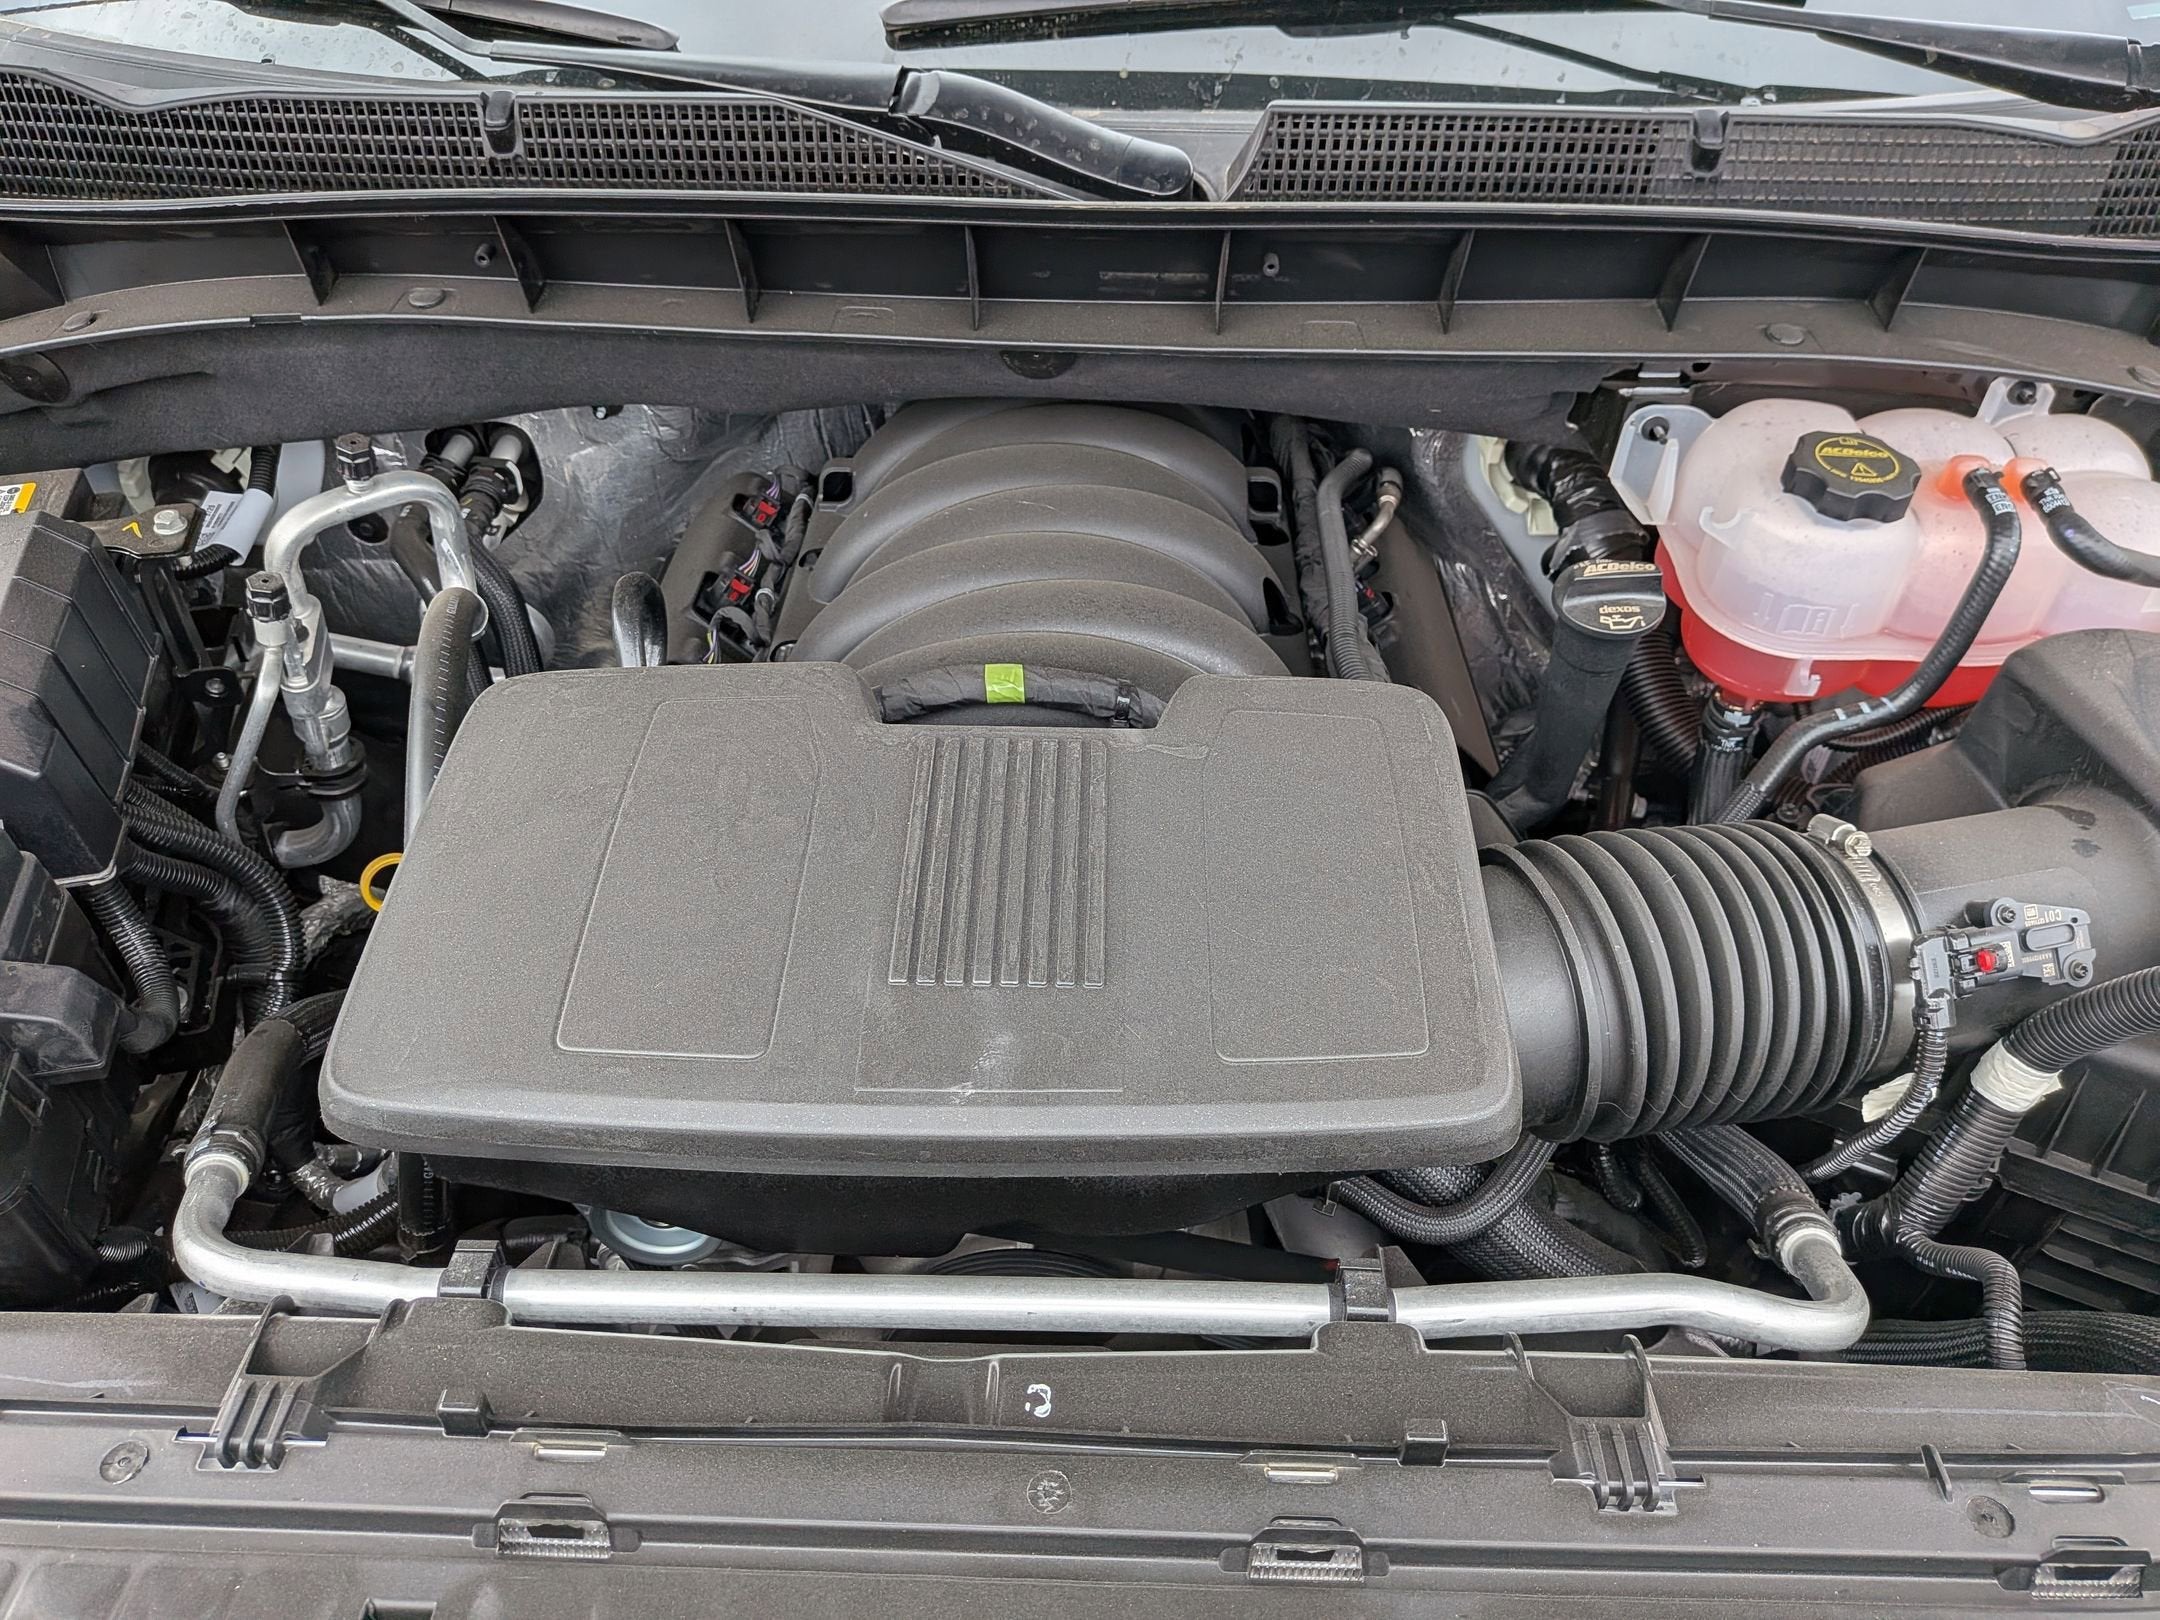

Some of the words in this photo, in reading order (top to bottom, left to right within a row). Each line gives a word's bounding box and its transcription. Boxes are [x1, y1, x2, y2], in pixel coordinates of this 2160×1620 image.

[1819, 446, 1889, 458] ACDelco
[1583, 561, 1656, 575] ACDelco
[1598, 604, 1641, 614] dexos
